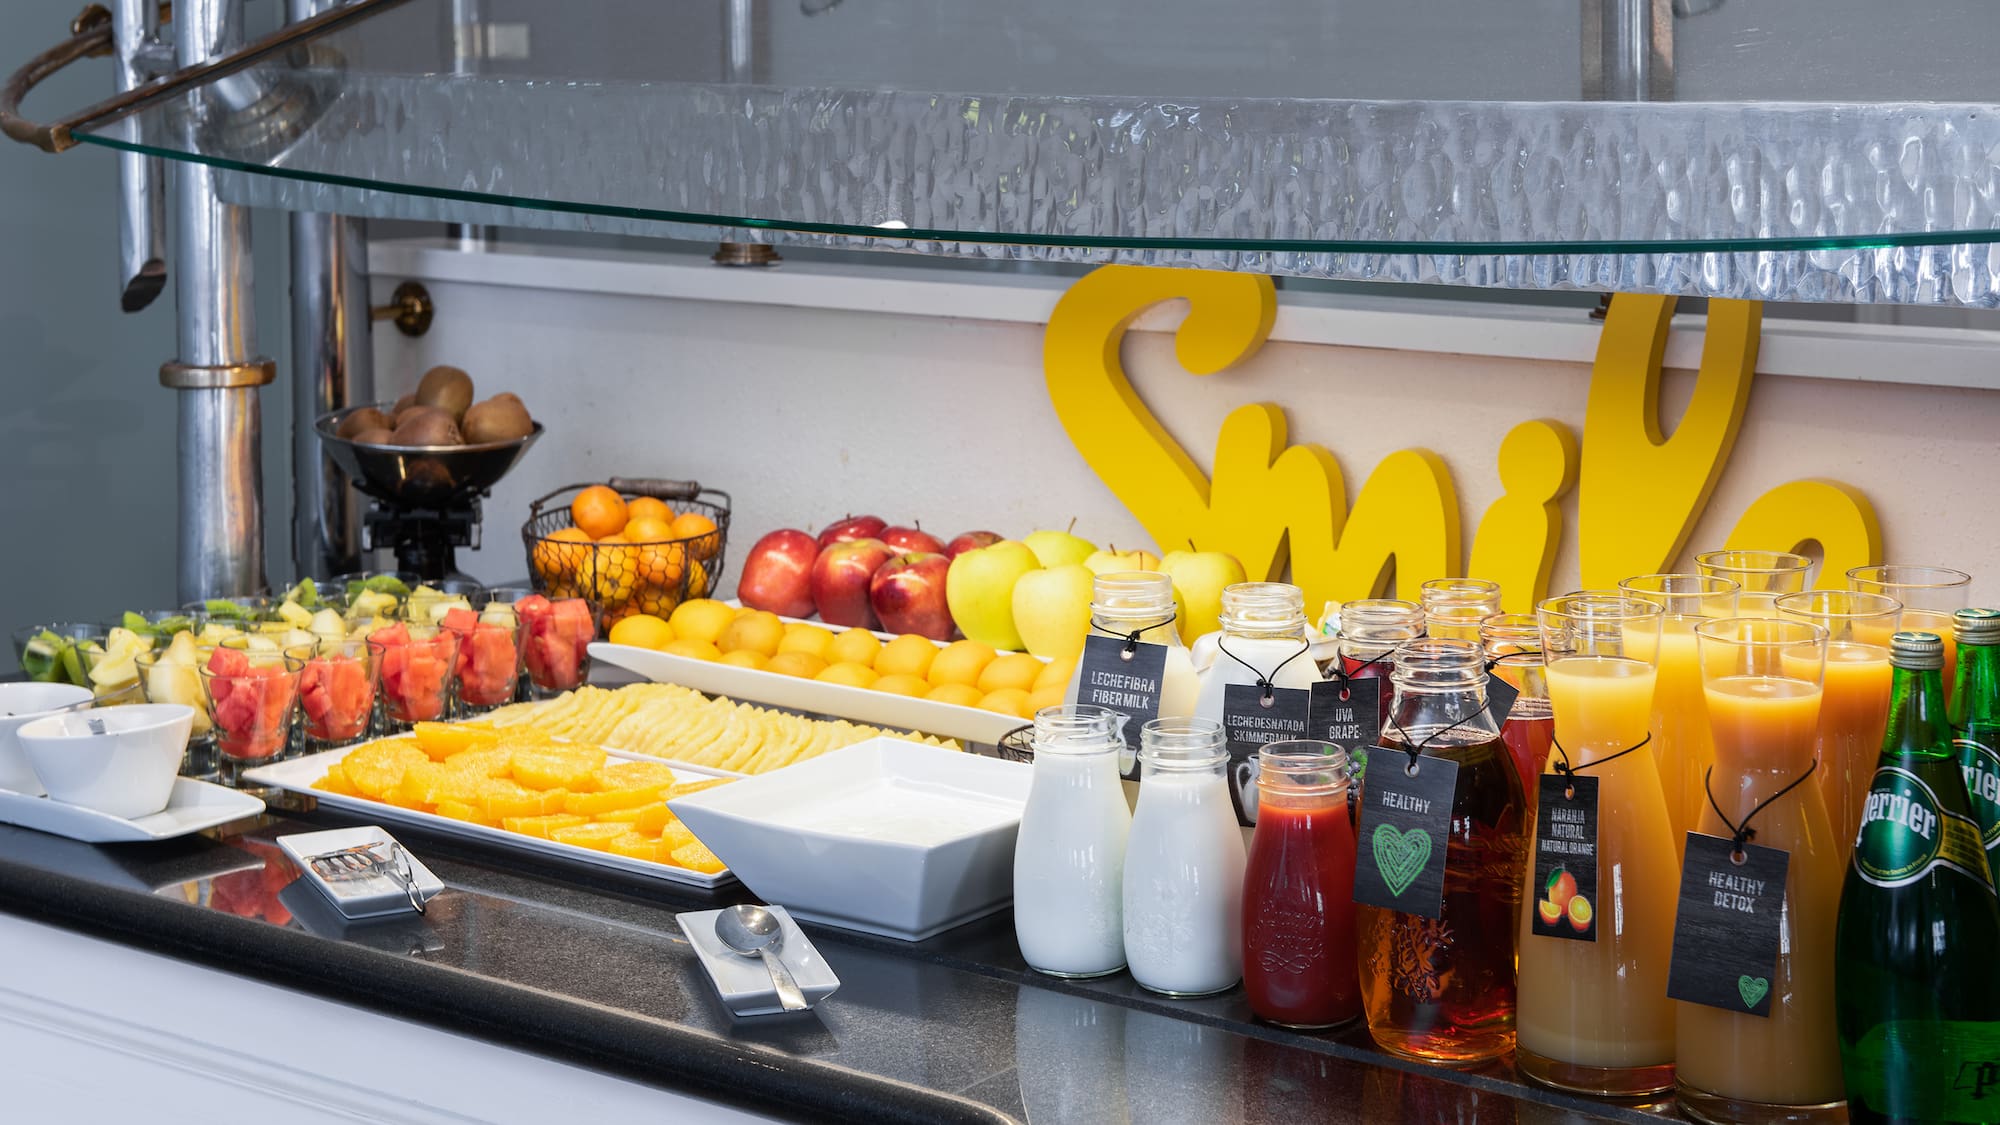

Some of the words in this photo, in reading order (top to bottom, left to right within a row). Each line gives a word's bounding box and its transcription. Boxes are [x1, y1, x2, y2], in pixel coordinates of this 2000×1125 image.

[1335, 708, 1353, 722] UVA
[1329, 725, 1360, 739] GRAPE
[1382, 791, 1431, 814] HEALTHY
[1551, 808, 1585, 824] NARANJA
[1551, 823, 1585, 840] NATURAL
[1541, 840, 1569, 853] NATURAL
[1569, 841, 1594, 856] ORANGE
[1708, 871, 1765, 896] HEALTHY
[1713, 891, 1756, 913] DETOX
